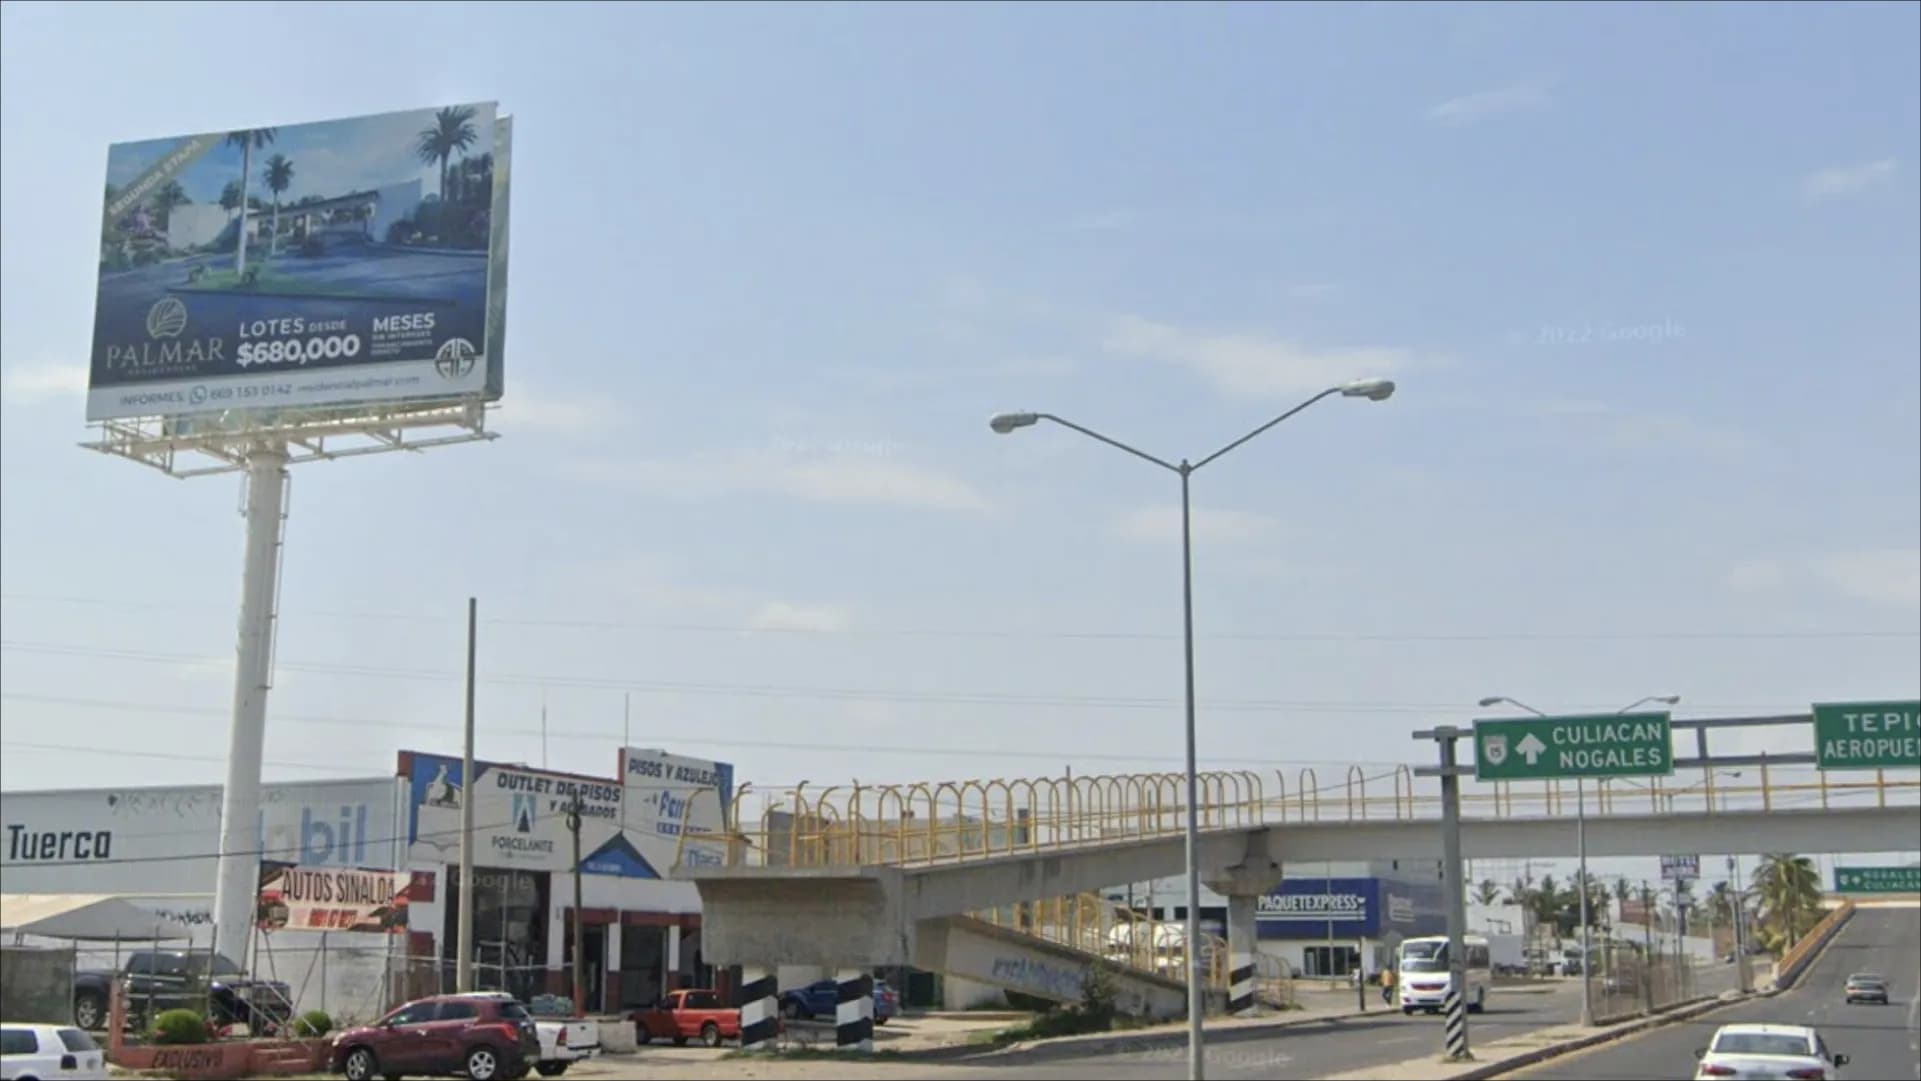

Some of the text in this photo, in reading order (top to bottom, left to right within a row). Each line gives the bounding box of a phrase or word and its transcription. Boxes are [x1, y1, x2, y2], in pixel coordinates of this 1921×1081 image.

[239, 318, 305, 338] LOTES
[373, 312, 435, 332] MESES
[106, 337, 226, 369] PALMAR
[236, 333, 361, 368] $680,000
[1842, 711, 1920, 732] TEPI
[1552, 723, 1662, 745] CULIACAN
[1559, 748, 1662, 769] NOGALES
[1823, 737, 1920, 759] AEROPUE
[628, 757, 662, 778] PISOS
[665, 764, 674, 779] Y
[497, 772, 621, 803] OUTLET DE PISOS
[7, 824, 112, 860] Tuerca
[282, 870, 395, 906] AUTOS SINALOA
[1257, 893, 1359, 912] PAQUETEXPRESS
